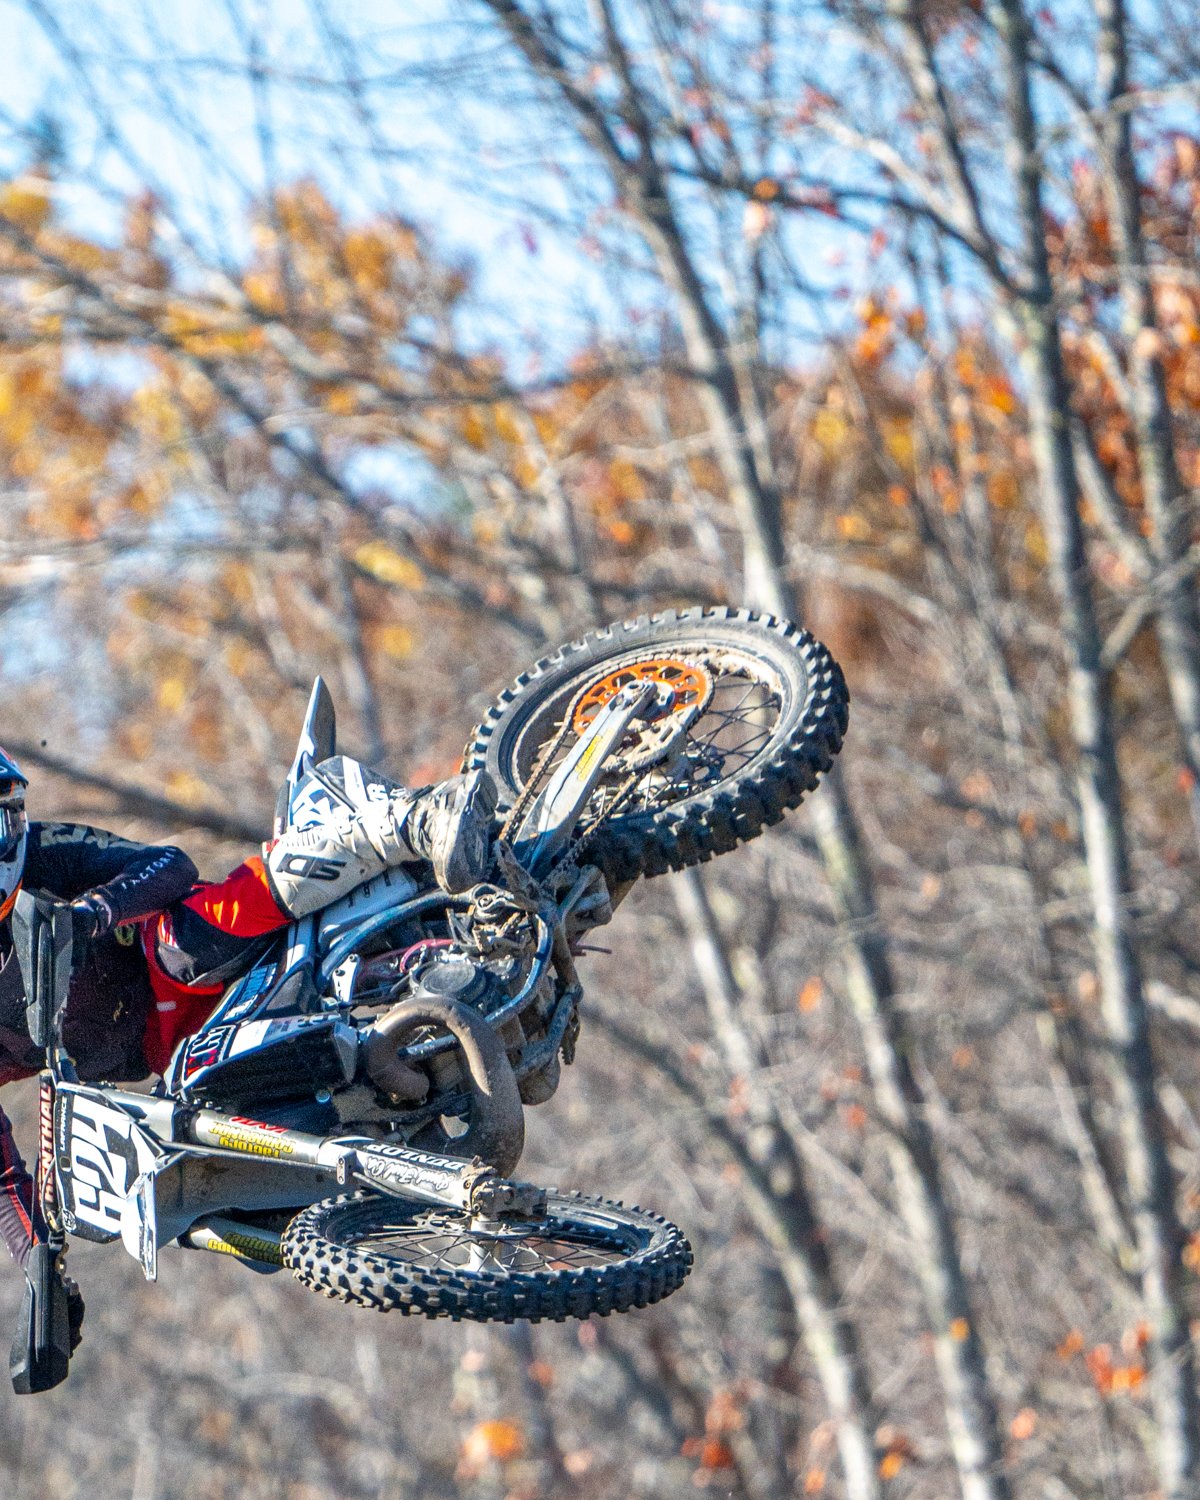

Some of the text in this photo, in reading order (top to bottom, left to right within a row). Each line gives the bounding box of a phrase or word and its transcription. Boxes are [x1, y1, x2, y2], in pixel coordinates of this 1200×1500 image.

[39, 1086, 56, 1203] RENTHAL
[59, 1097, 68, 1152] LAFRANCE
[71, 1094, 132, 1234] 624
[367, 1144, 468, 1170] DUNLOP
